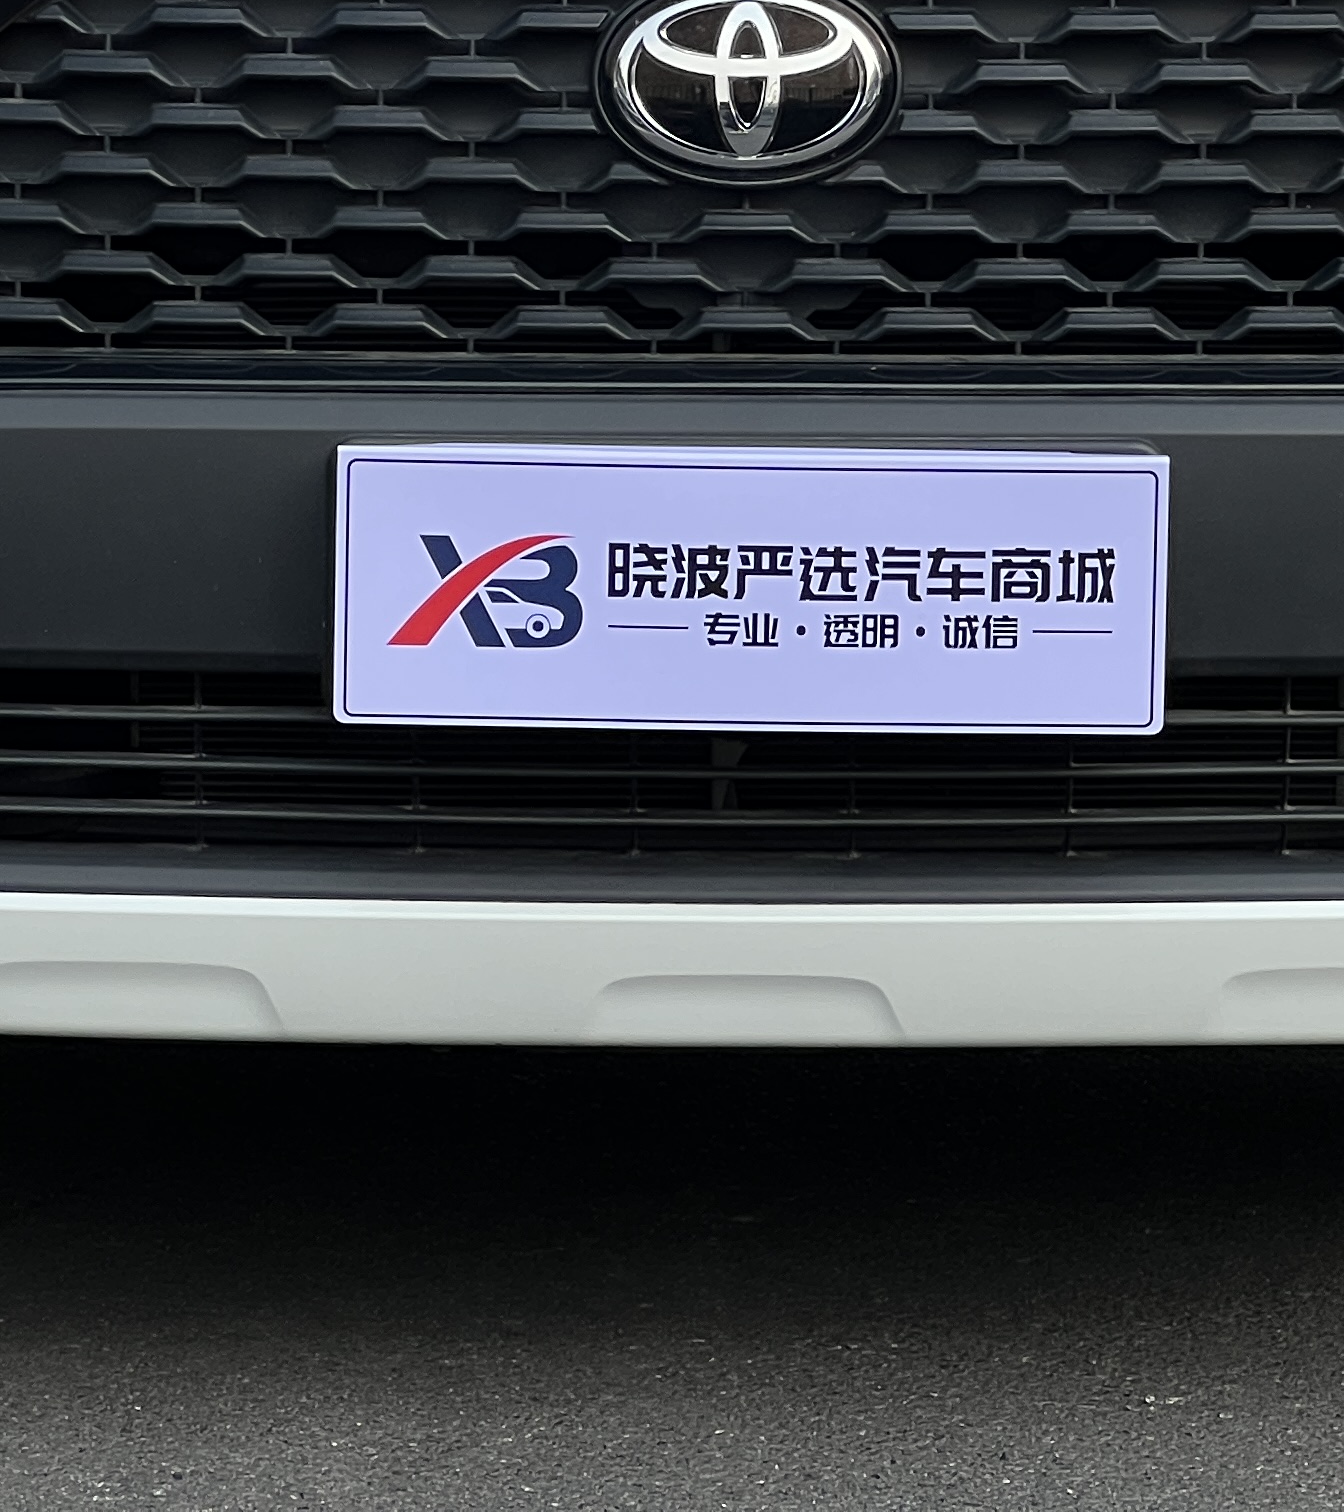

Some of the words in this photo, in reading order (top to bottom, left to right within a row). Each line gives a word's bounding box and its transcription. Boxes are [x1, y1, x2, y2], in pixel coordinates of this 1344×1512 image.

[607, 542, 1116, 604] 晓波严选汽车商城
